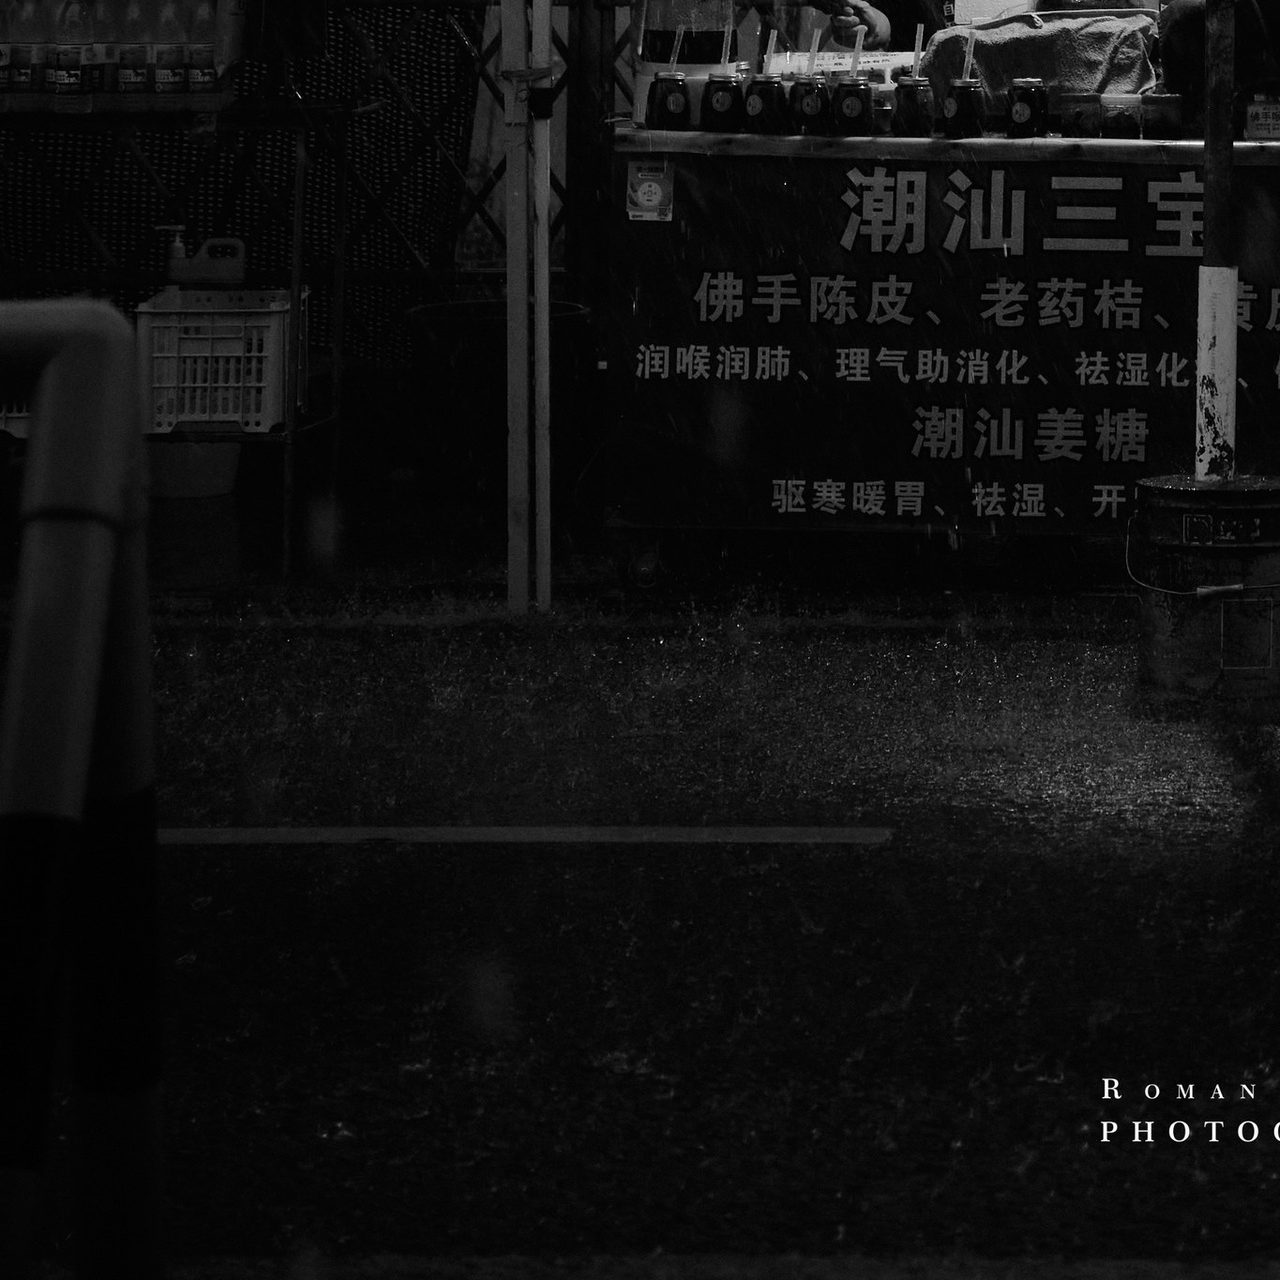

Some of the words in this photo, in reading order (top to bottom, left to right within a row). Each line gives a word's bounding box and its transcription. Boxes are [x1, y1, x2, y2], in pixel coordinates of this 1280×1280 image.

[839, 165, 1204, 257] 潮汕三宝
[910, 405, 1151, 464] 潮汕姜糖
